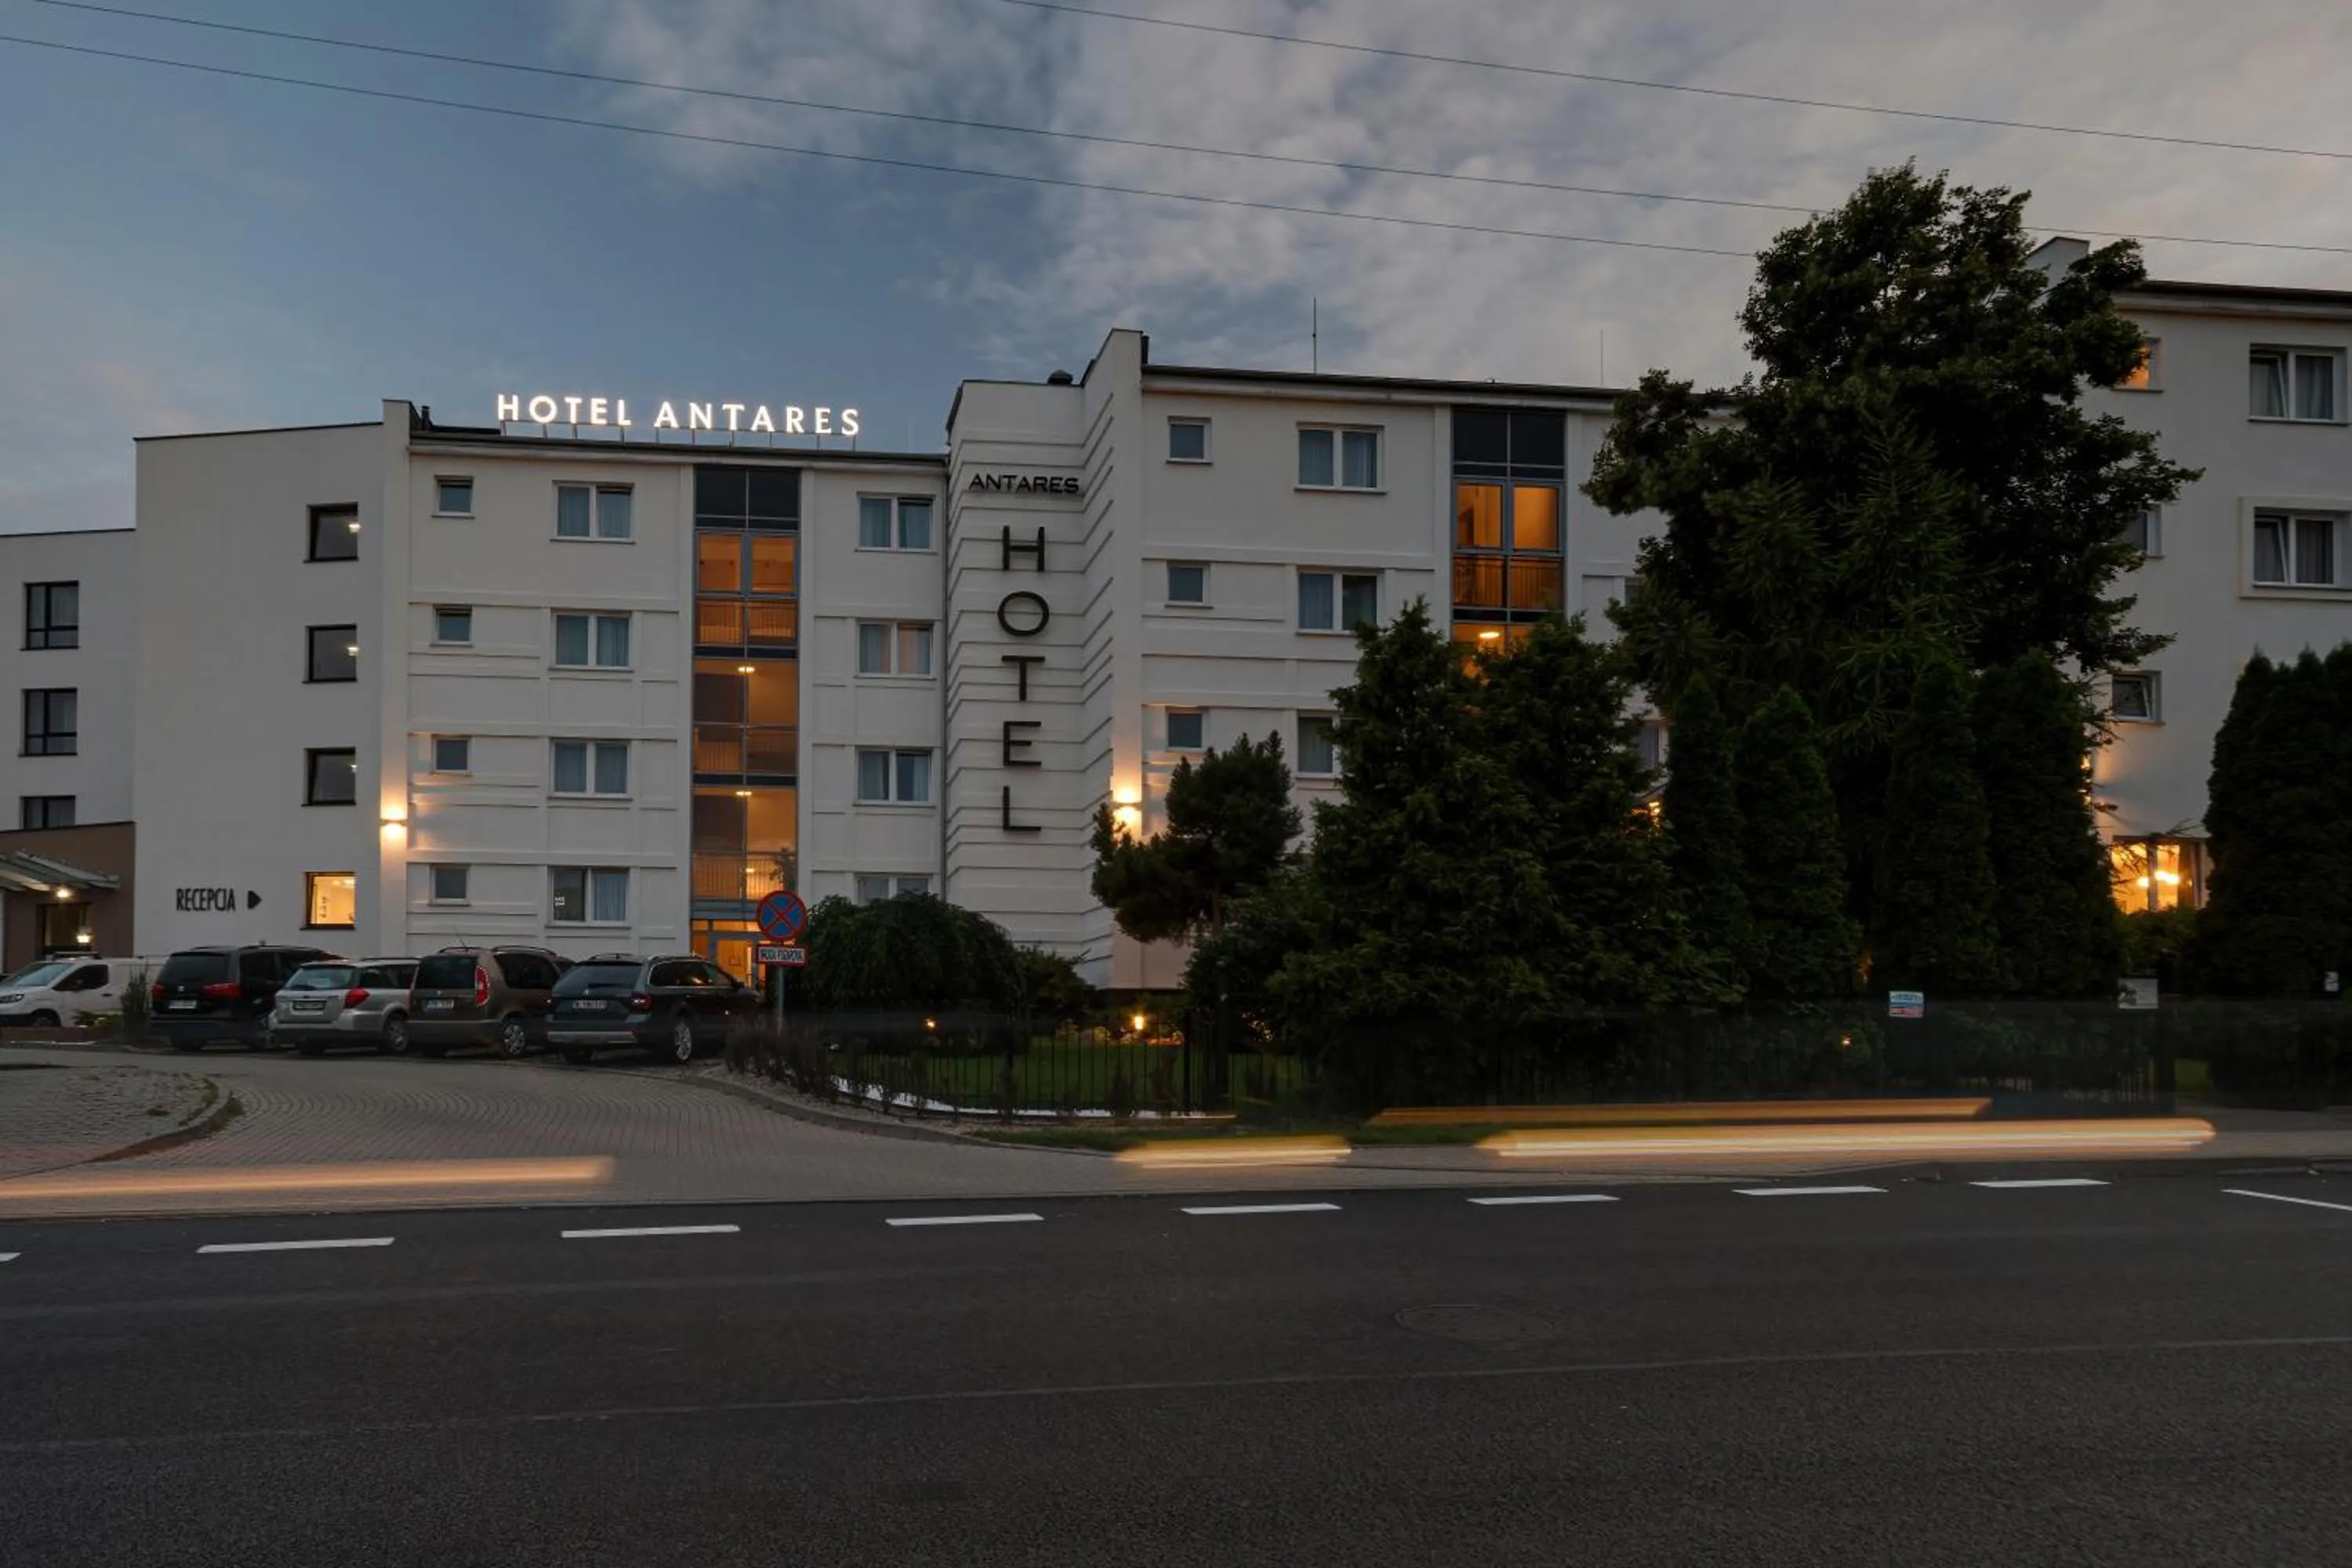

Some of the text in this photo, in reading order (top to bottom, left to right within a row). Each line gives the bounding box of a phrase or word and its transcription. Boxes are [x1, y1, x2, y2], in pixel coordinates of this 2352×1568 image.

[497, 394, 859, 435] HOTEL ANTARES
[968, 473, 1080, 494] ANTARES
[997, 525, 1050, 832] HOTEL
